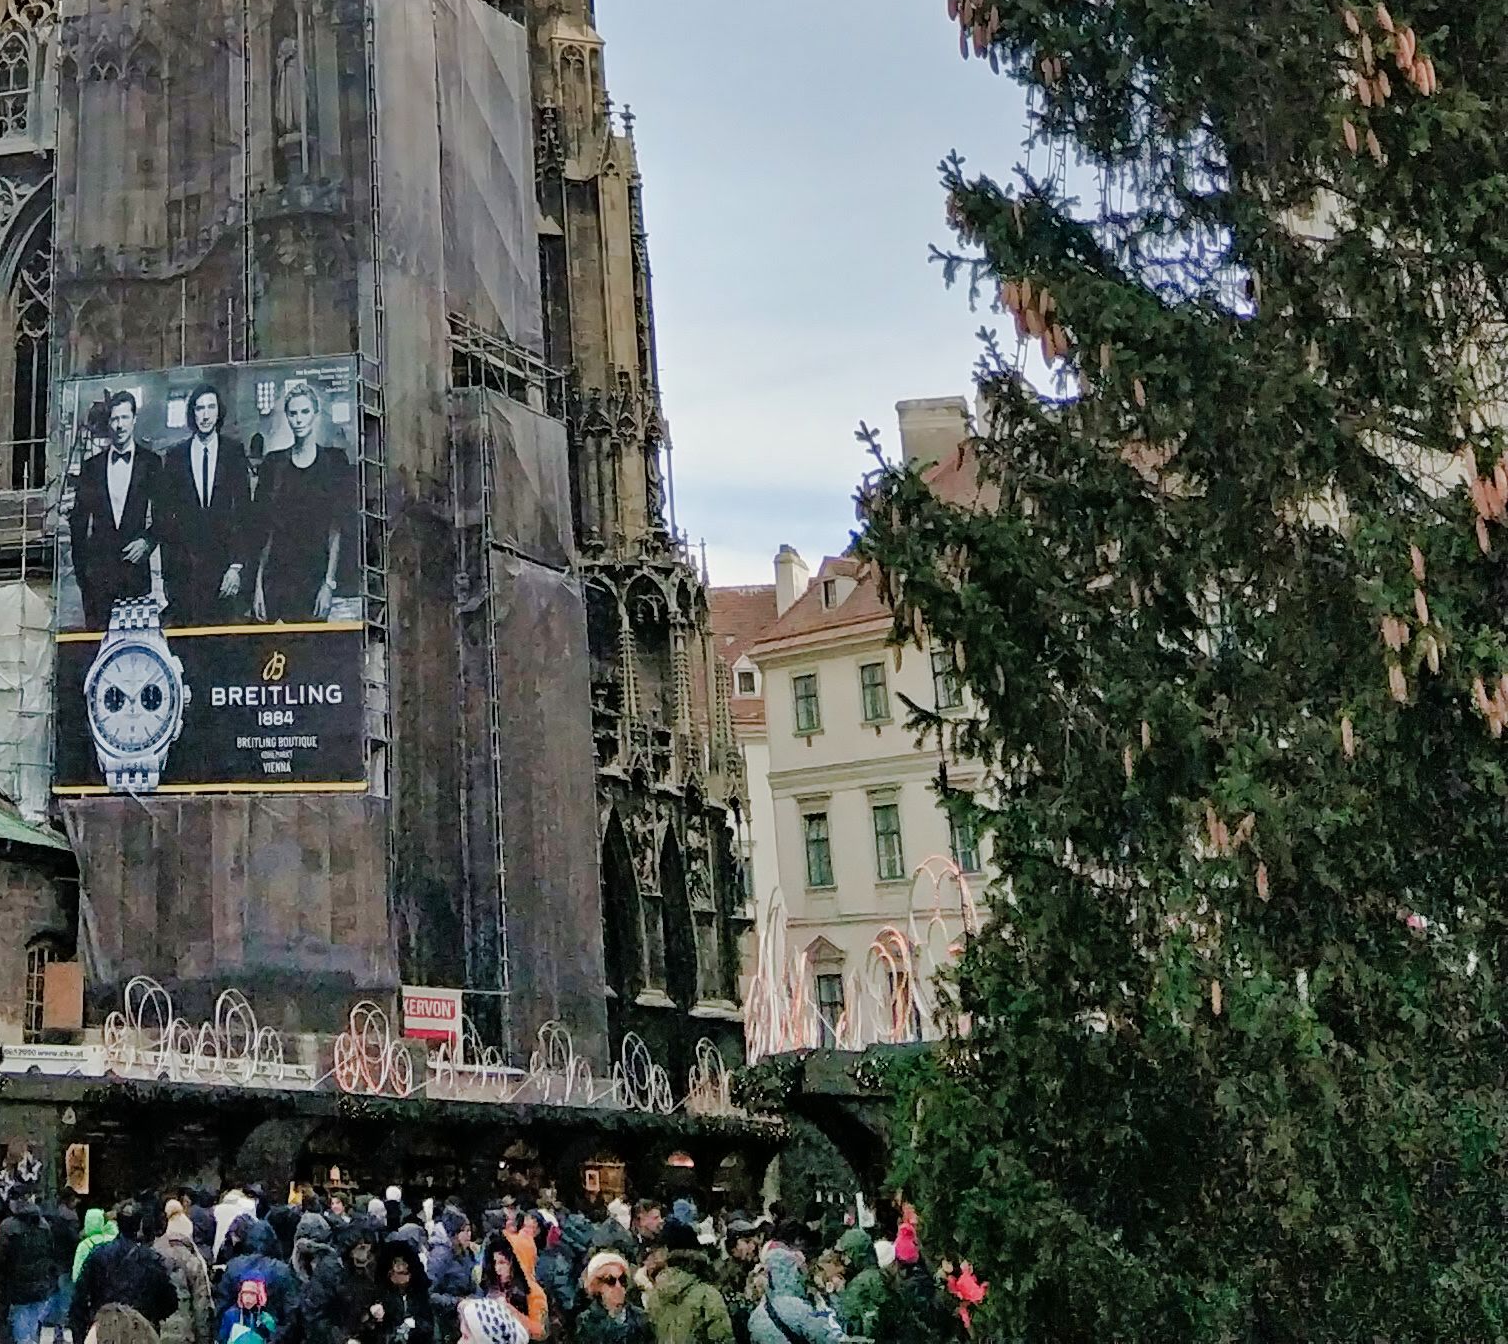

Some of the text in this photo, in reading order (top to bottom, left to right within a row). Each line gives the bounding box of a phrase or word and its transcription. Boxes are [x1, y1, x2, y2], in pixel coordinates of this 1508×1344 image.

[211, 684, 343, 706] BREITLING
[257, 710, 294, 726] 1884
[236, 735, 318, 749] BREITLING BOUTIQUE
[263, 760, 292, 774] VIENNA
